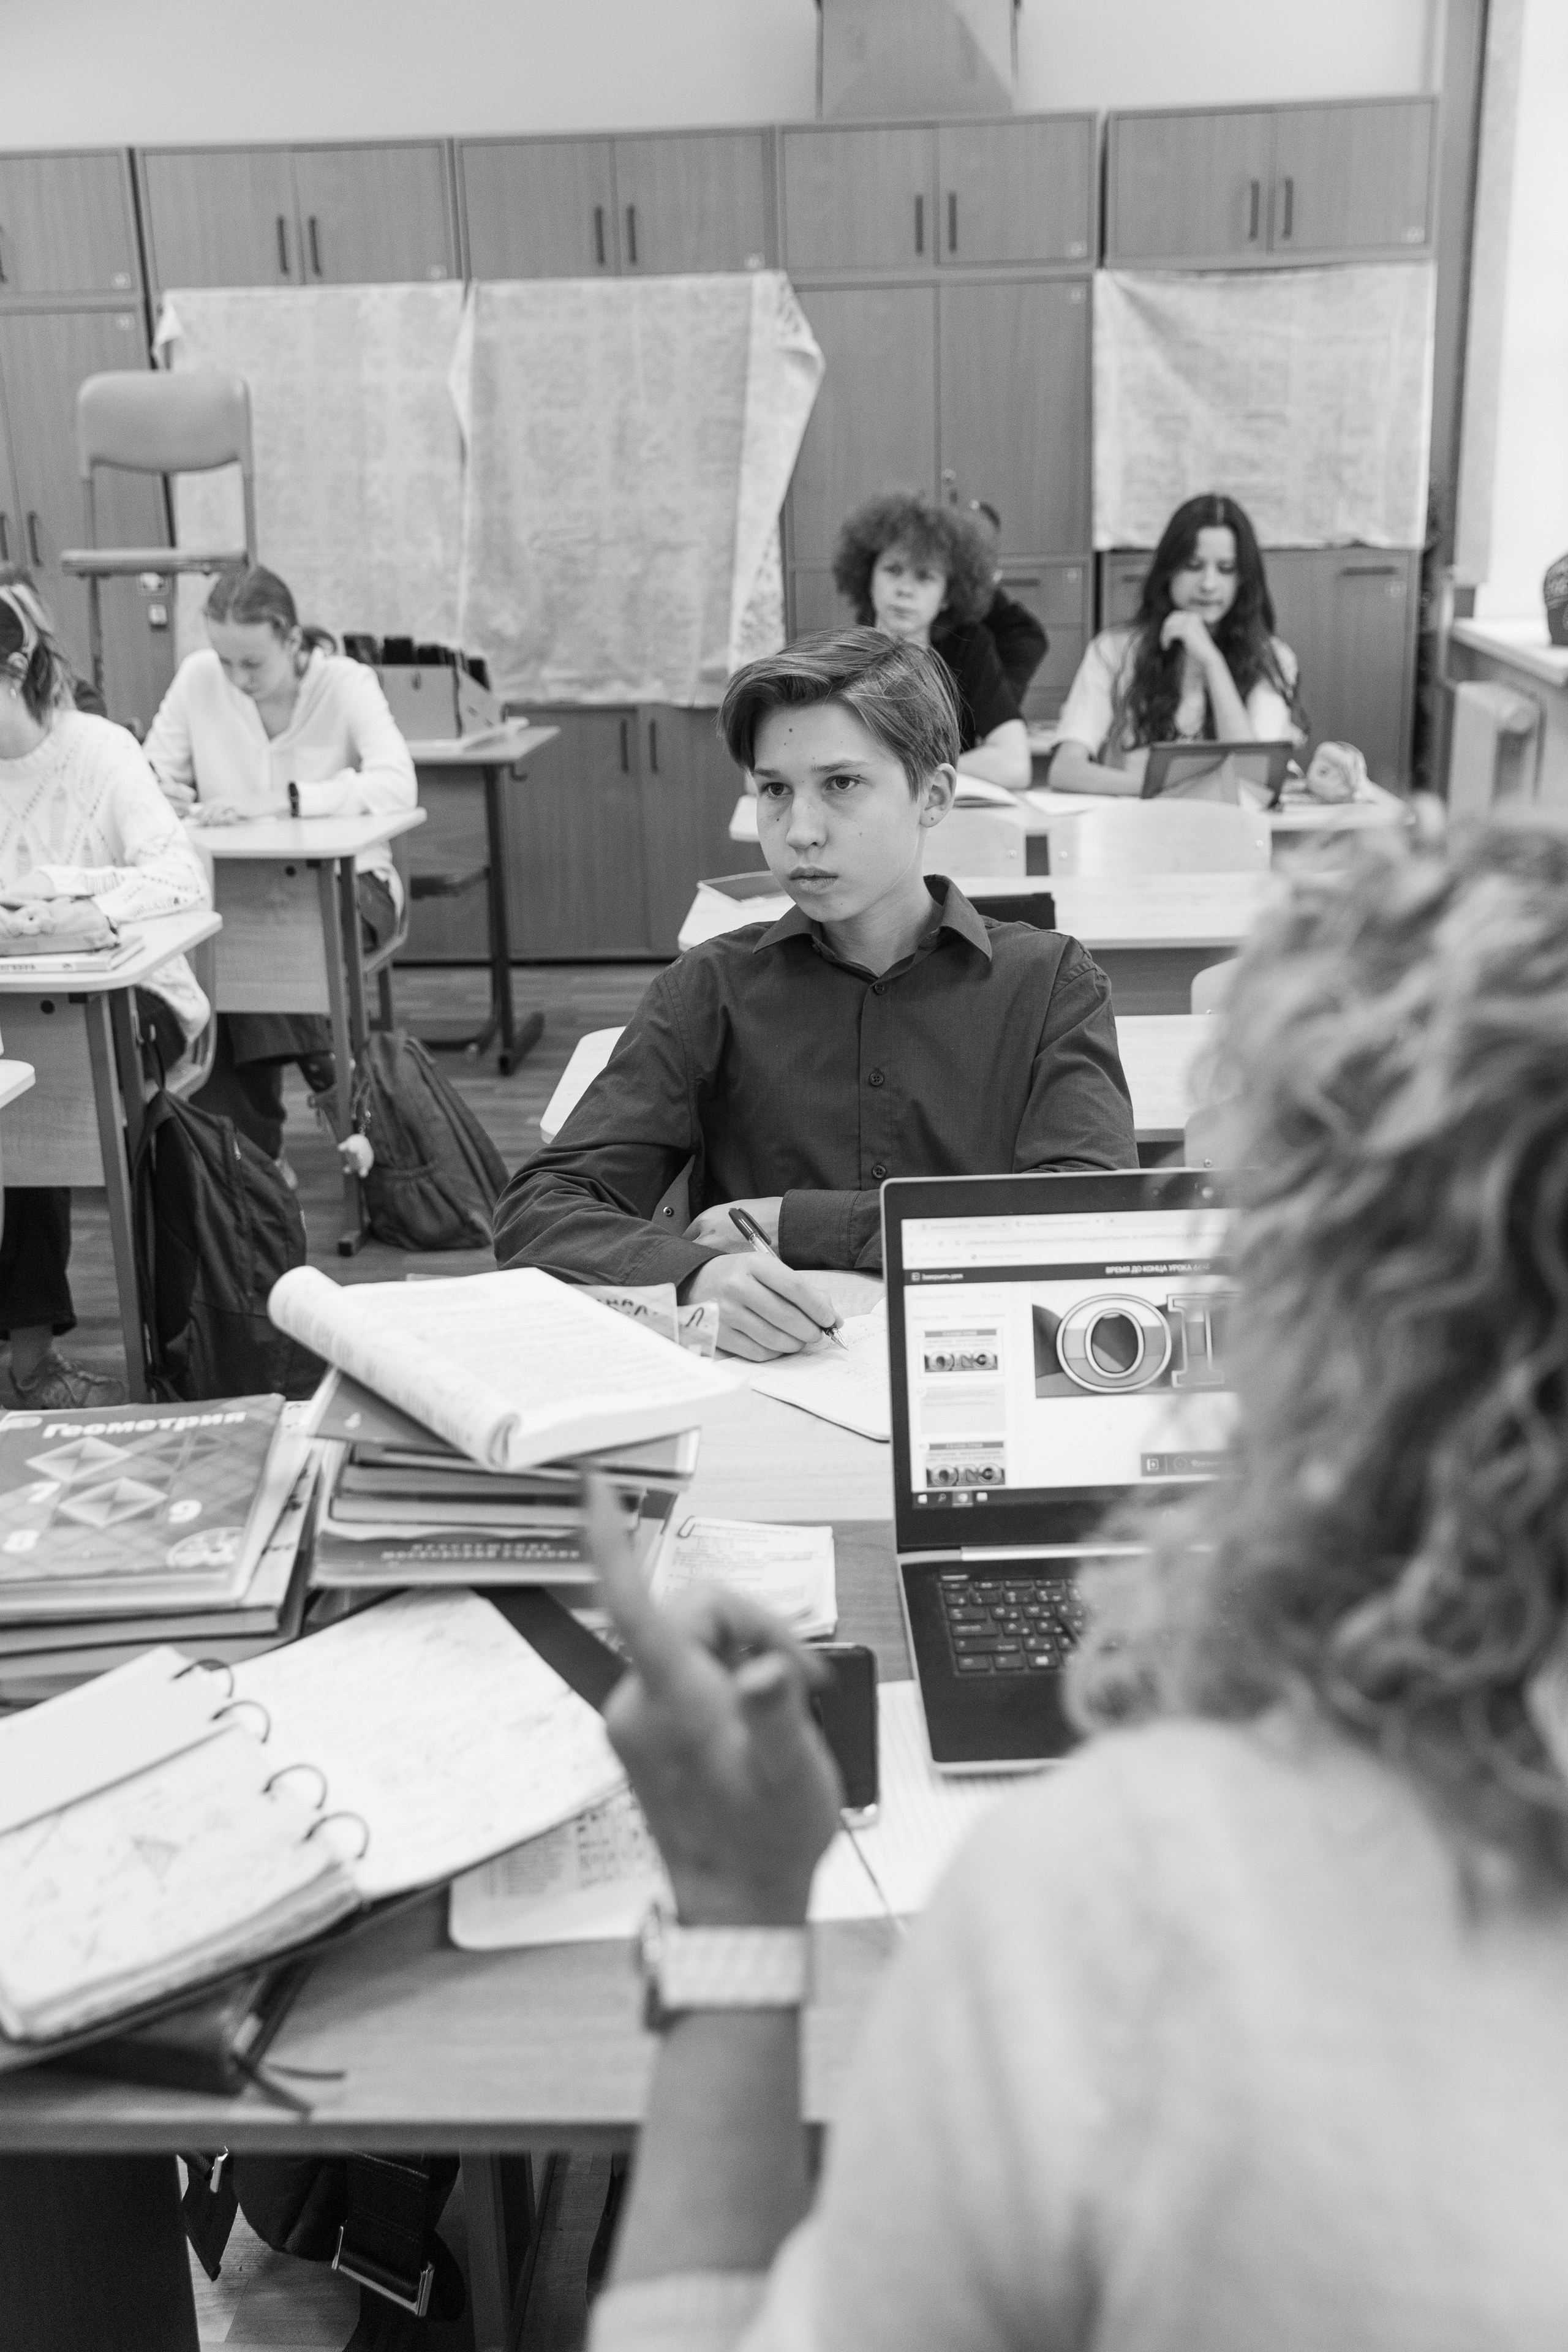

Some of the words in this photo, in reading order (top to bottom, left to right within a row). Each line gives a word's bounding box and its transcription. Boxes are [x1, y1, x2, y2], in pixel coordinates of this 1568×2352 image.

[1105, 1265, 1131, 1275] ВРЕМЯ
[1131, 1265, 1142, 1274] ДО
[1143, 1264, 1168, 1274] КОНЦА
[1168, 1264, 1193, 1272] УРОКА
[42, 1411, 247, 1439] Геометрия
[27, 1481, 61, 1504] 7
[168, 1499, 203, 1525] 9
[2, 1529, 40, 1553] 8
